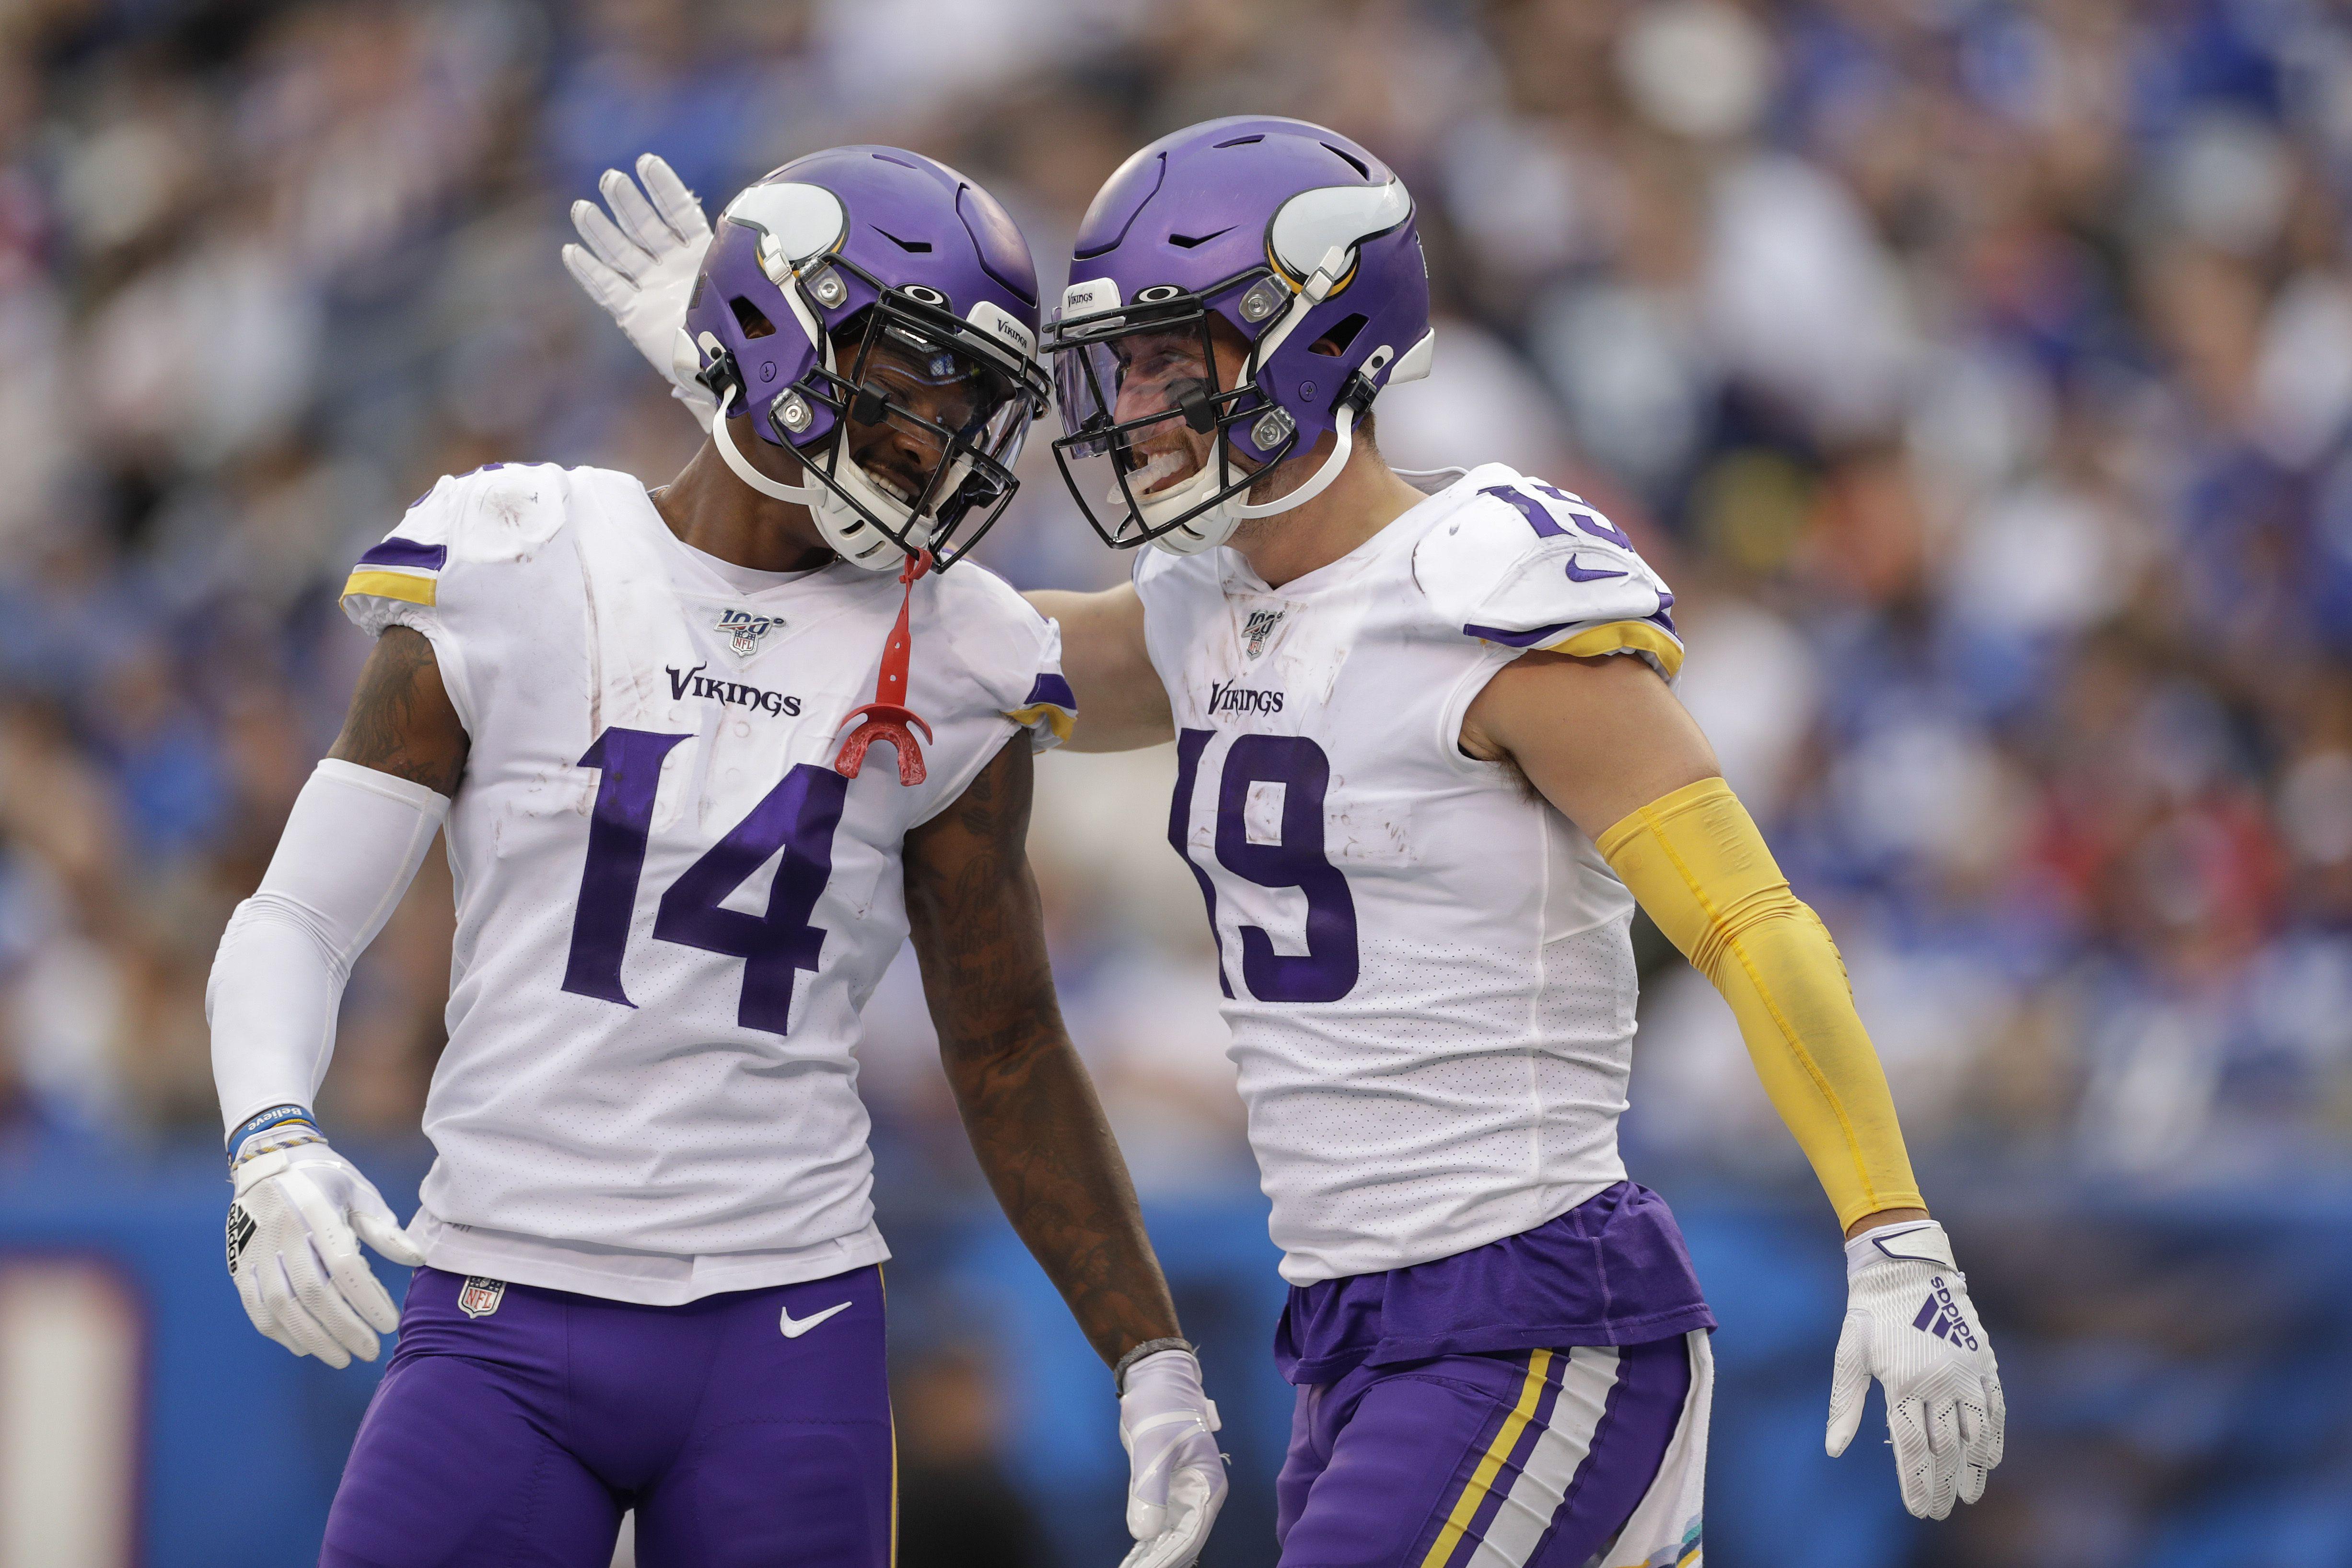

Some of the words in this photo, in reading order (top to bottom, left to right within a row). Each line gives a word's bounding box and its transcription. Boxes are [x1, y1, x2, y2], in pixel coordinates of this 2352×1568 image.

[1068, 291, 1093, 308] VIKINGS
[998, 318, 1027, 348] VIKINGS
[735, 638, 752, 650] NFL
[1250, 641, 1260, 652] NFL
[666, 661, 801, 717] VIKINGS
[1208, 678, 1284, 717] VIKINGS
[561, 726, 849, 1036] 14
[1168, 728, 1359, 1002] 19
[247, 1108, 302, 1130] Believe
[229, 1203, 238, 1273] adidas
[466, 1289, 492, 1309] NFL
[1931, 1276, 1978, 1351] adidas
